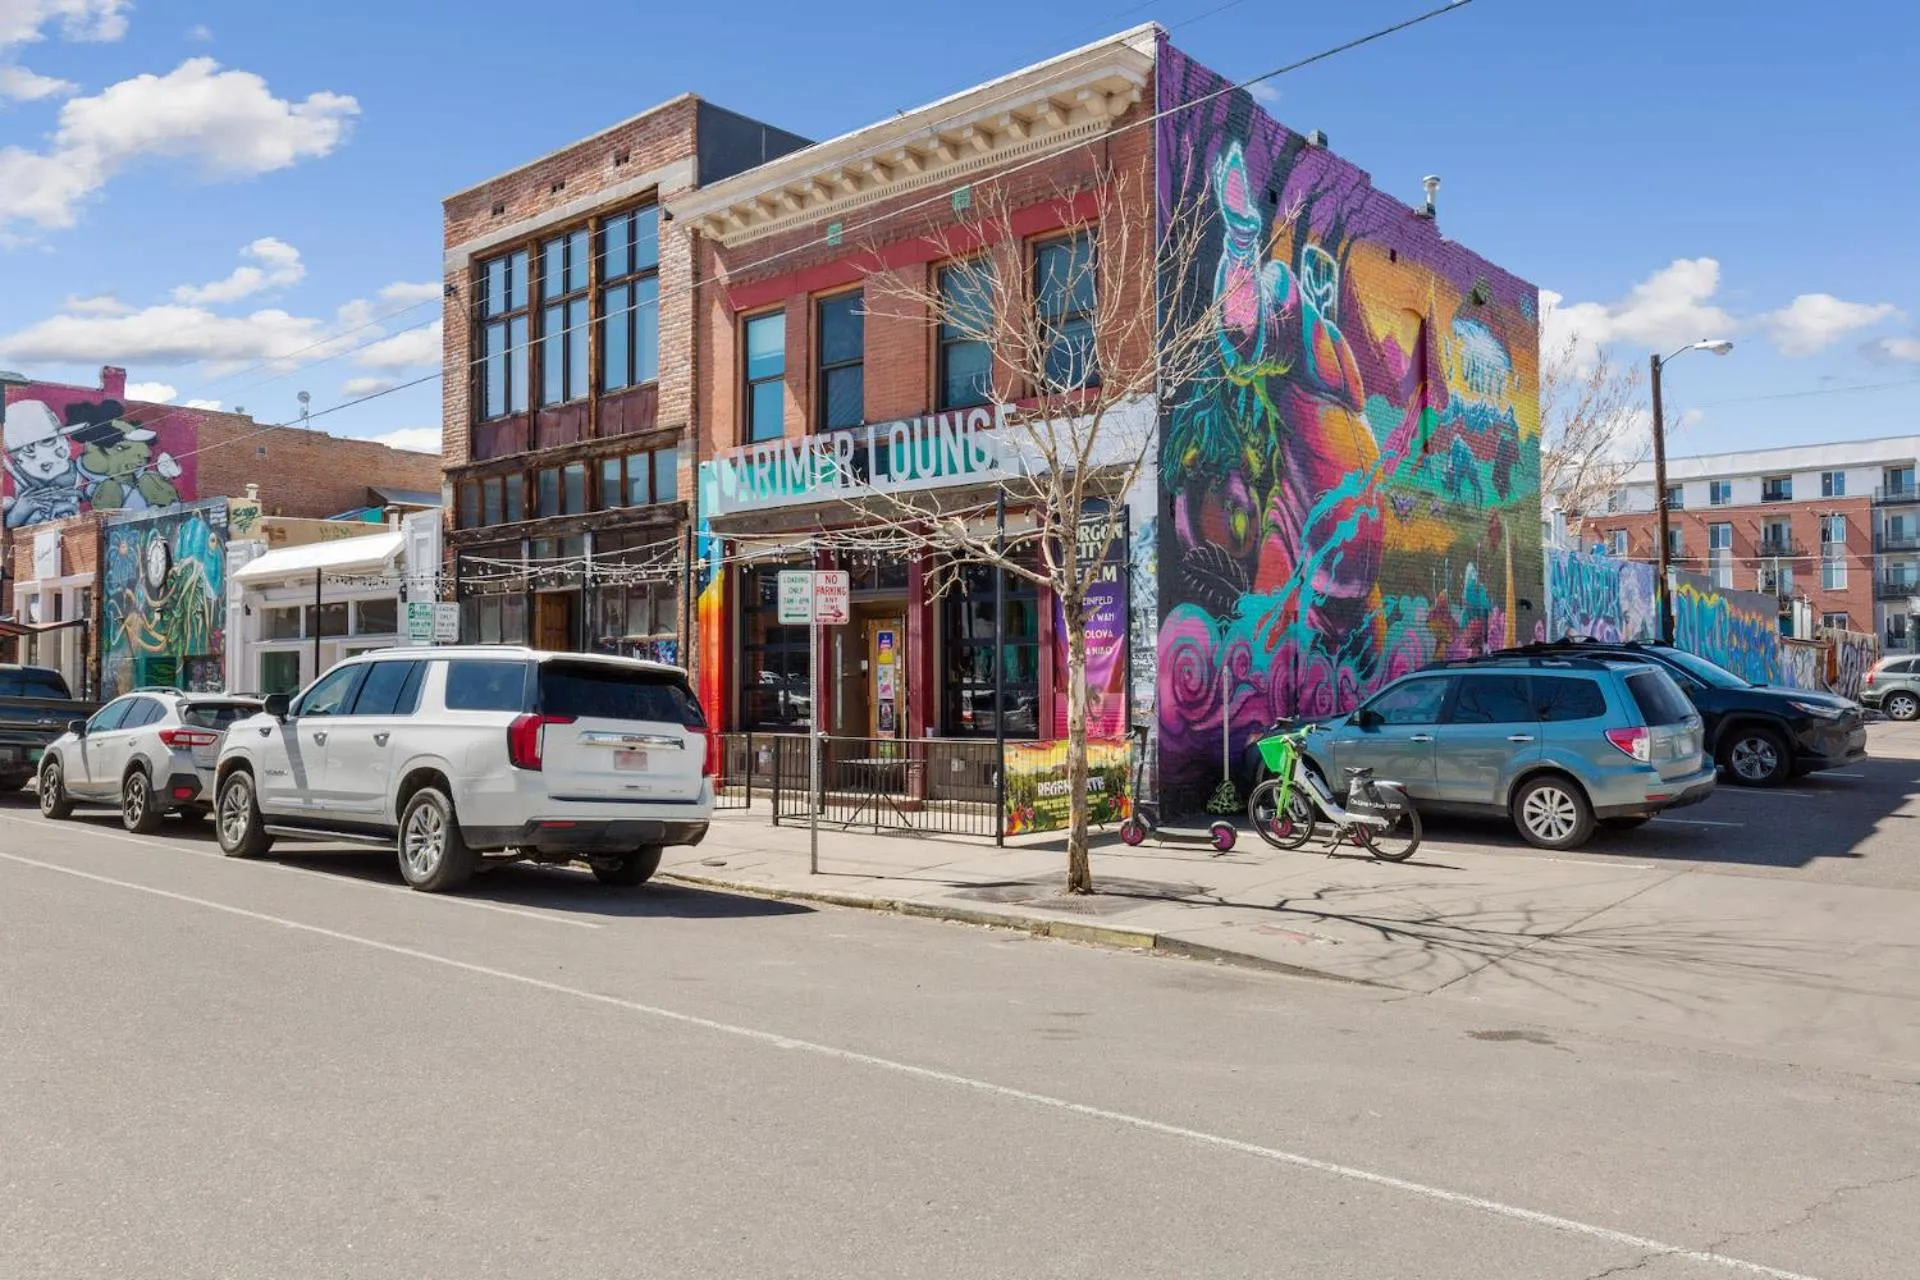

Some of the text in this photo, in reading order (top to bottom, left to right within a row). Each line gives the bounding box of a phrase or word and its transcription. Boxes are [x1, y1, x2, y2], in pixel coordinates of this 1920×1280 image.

[713, 402, 1017, 508] LARIMER LOUNGE
[825, 574, 838, 585] NO
[816, 586, 847, 596] PARKING
